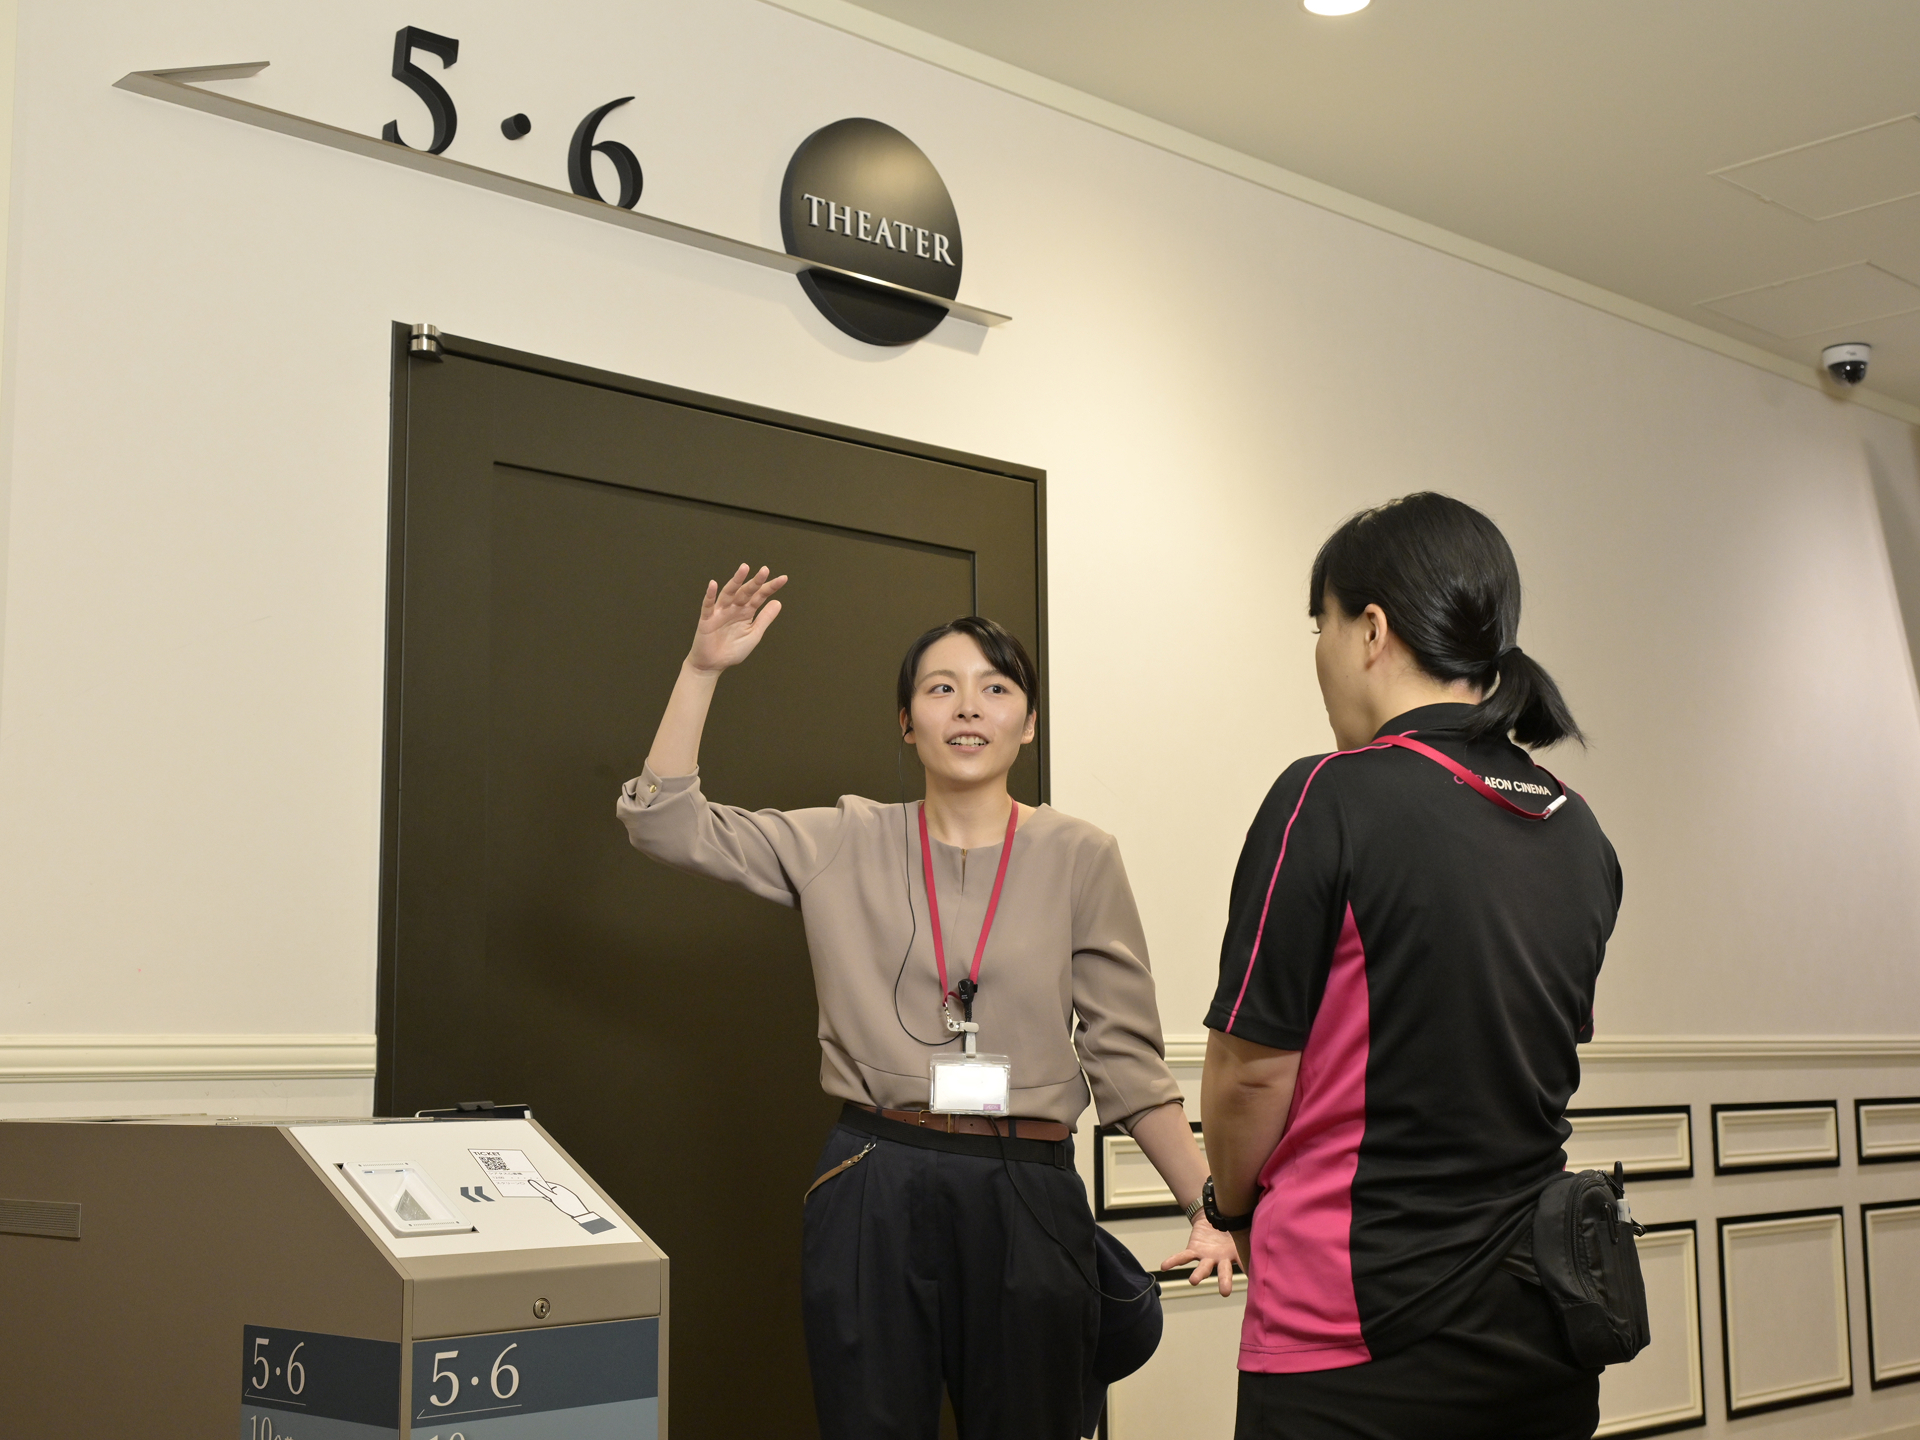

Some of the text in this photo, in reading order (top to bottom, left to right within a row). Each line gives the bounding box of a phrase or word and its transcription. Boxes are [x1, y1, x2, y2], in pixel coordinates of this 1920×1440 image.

[802, 192, 956, 267] THEATER
[1484, 776, 1513, 791] AEON
[1513, 781, 1552, 796] CINEMA
